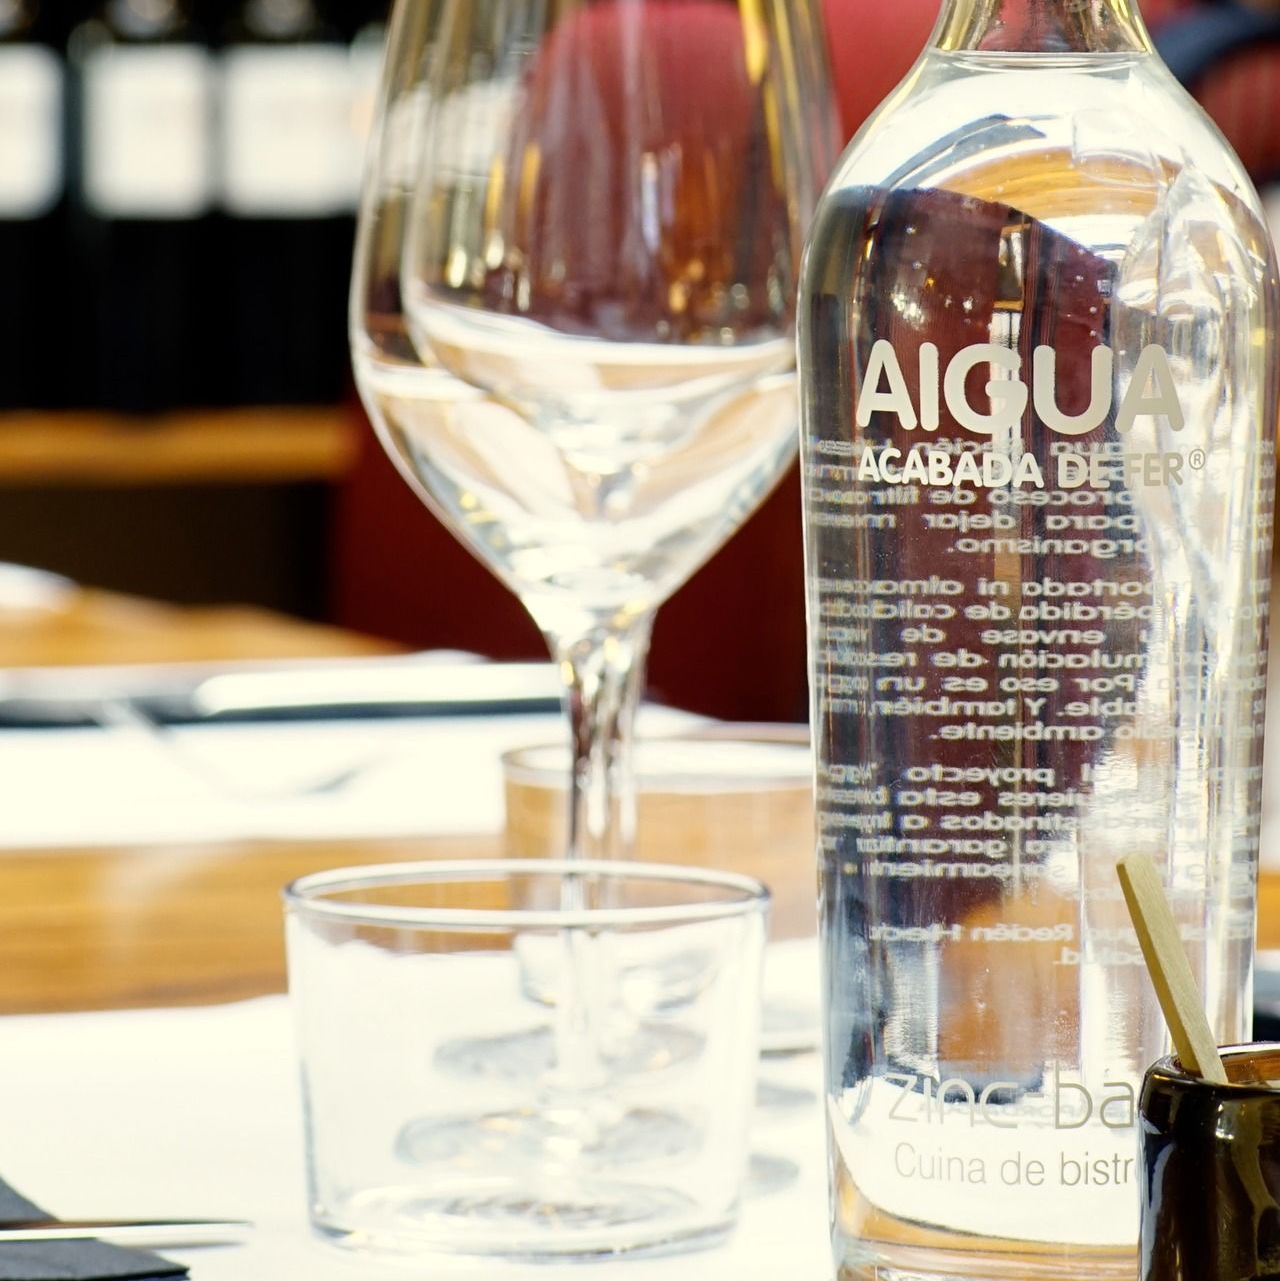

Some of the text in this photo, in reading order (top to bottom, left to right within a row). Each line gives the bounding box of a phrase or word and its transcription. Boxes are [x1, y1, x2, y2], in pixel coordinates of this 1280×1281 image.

[855, 338, 1186, 435] AIGUA
[857, 447, 1045, 488] ACABADA
[1058, 452, 1112, 489] DE
[882, 1060, 1136, 1130] zinc-ba
[893, 1141, 1137, 1187] Cuina de bistr
